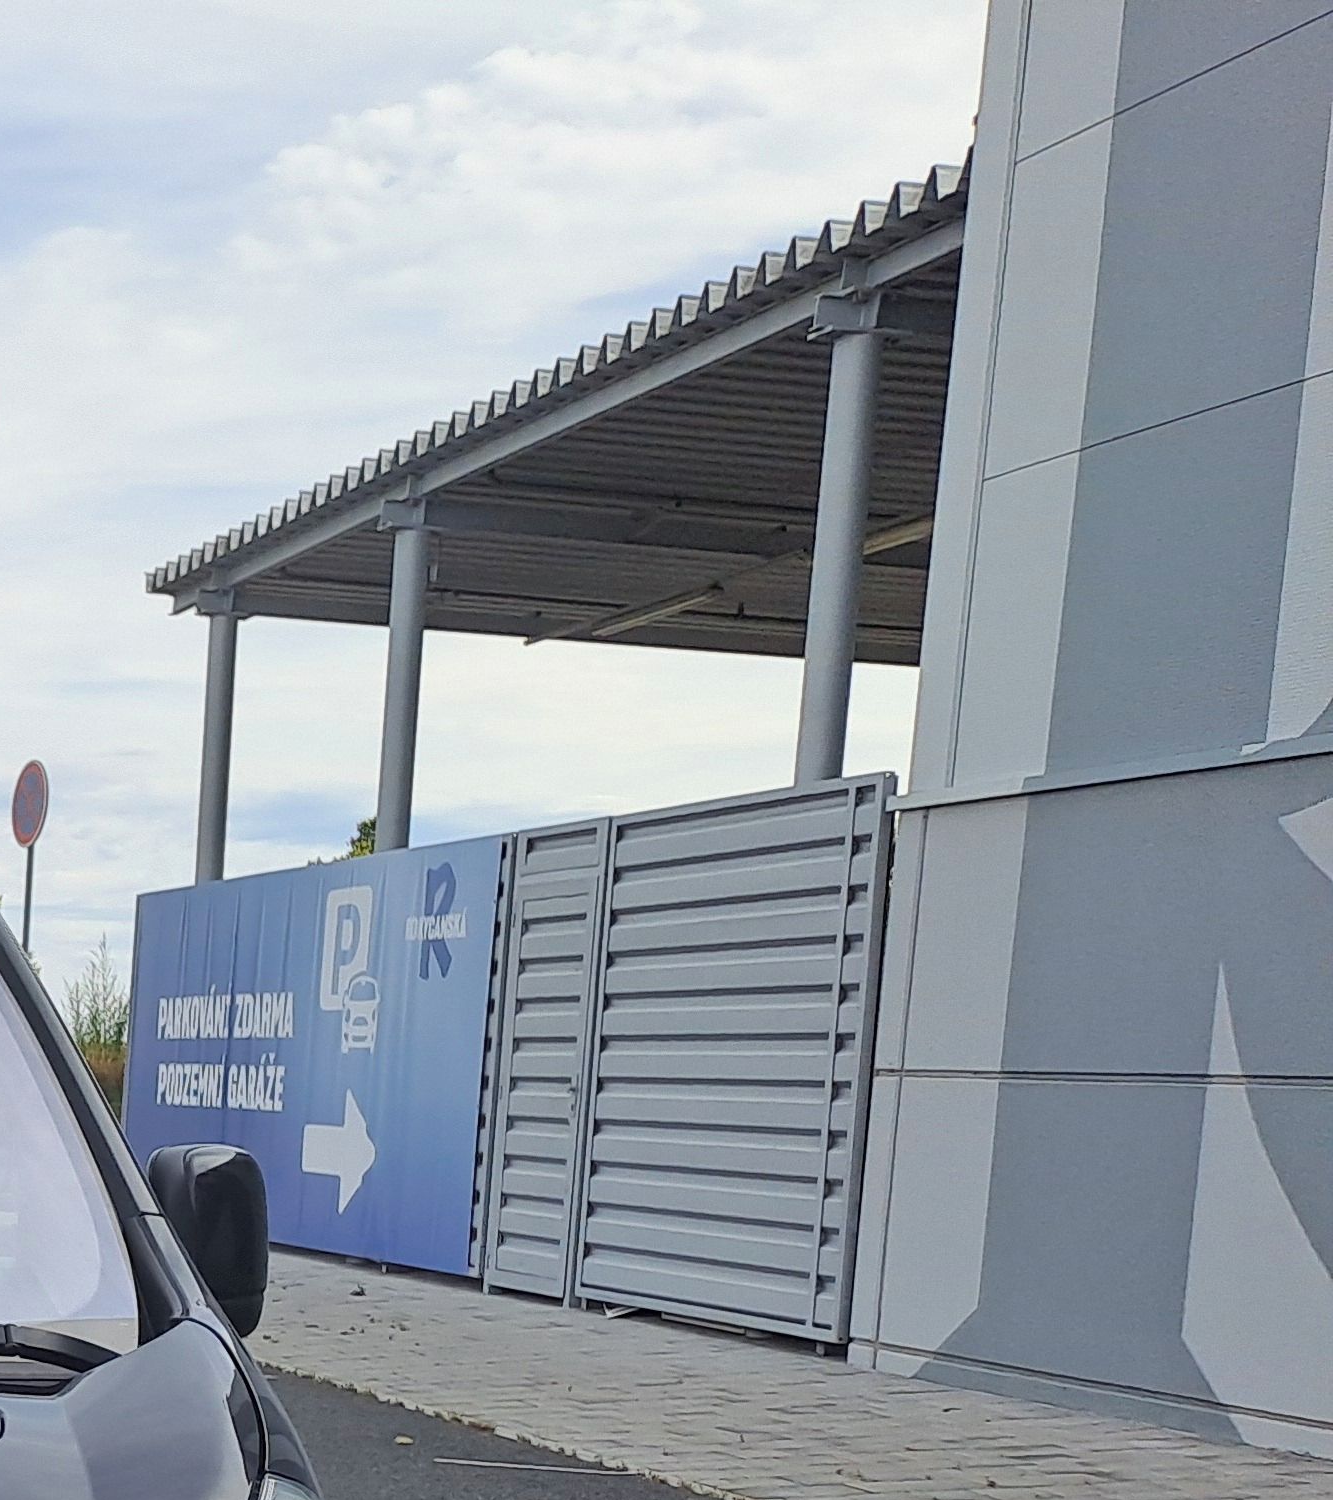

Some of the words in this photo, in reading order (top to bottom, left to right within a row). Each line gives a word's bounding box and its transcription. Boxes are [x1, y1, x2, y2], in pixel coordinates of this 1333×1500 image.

[331, 904, 361, 995] P
[157, 983, 232, 1040] PARKOVÁNÍ
[234, 991, 294, 1039] ZDARMA
[157, 1053, 227, 1109] PODZEMNÍ
[227, 1052, 286, 1112] GARÁŽE
